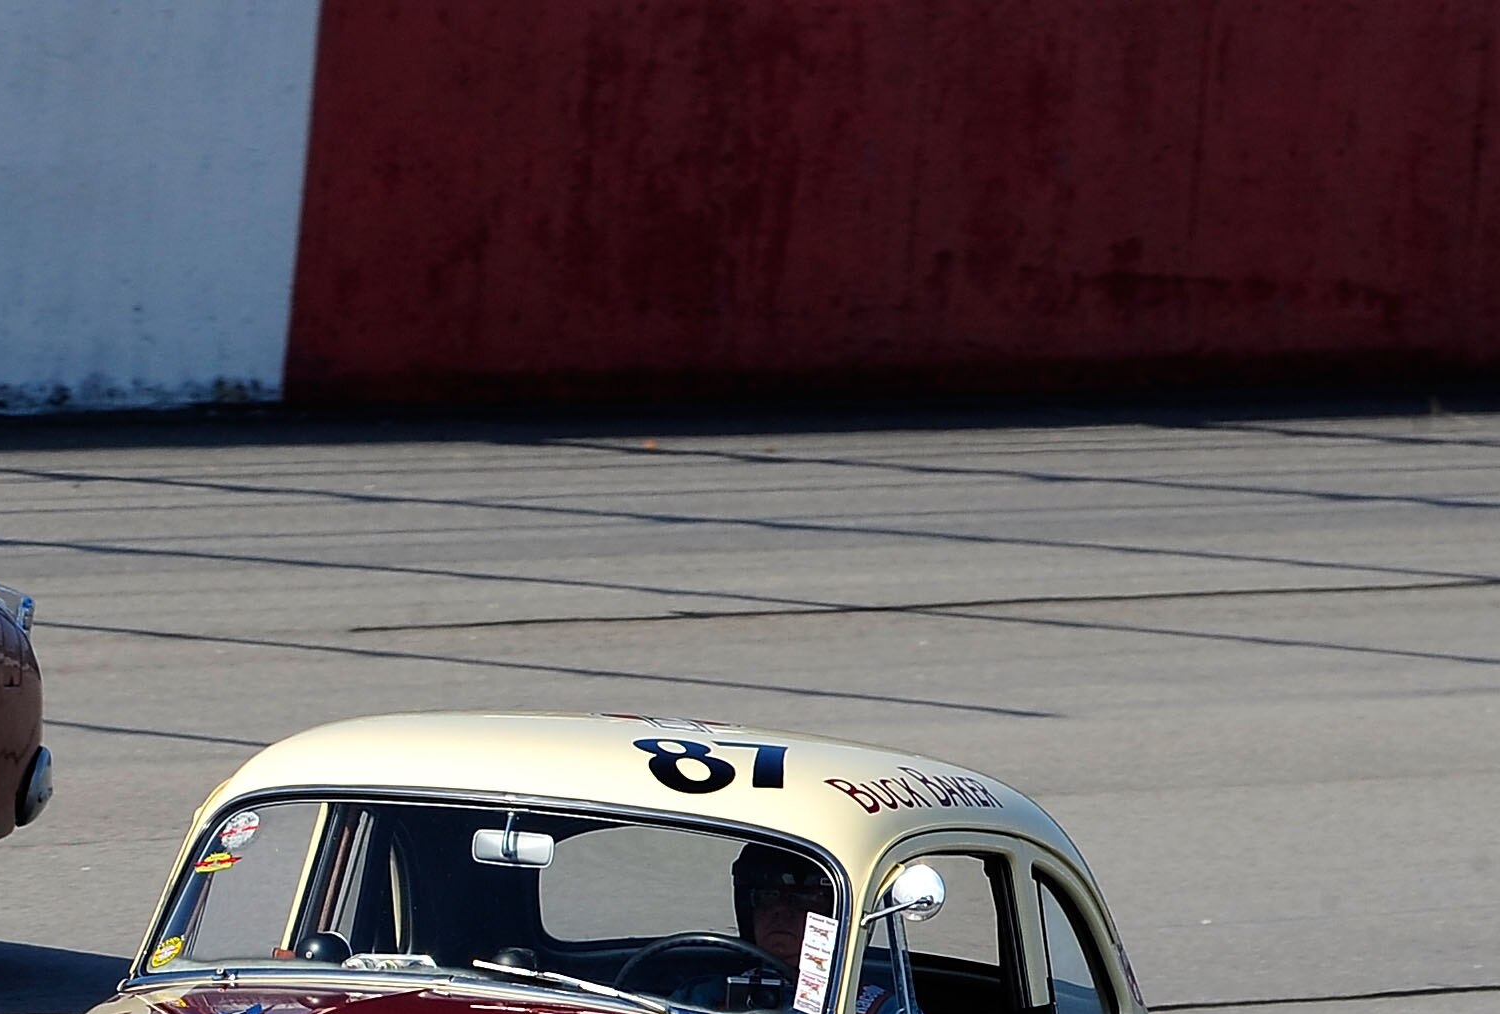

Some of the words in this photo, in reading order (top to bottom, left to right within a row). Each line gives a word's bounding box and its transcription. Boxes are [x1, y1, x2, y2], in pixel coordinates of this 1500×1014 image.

[632, 737, 789, 795] 87
[823, 778, 933, 815] BUCK
[896, 765, 1004, 809] BAKER
